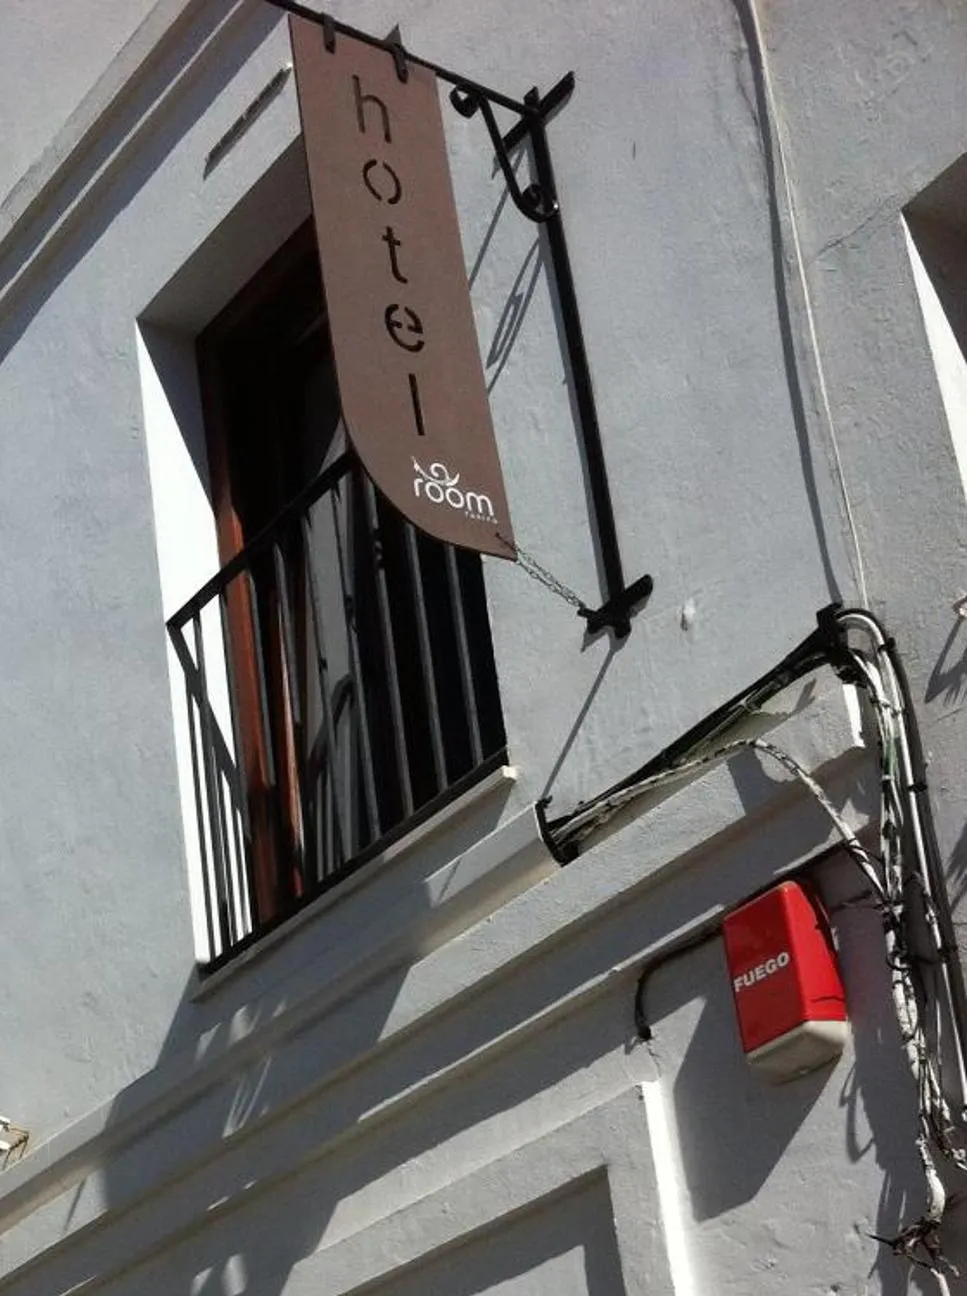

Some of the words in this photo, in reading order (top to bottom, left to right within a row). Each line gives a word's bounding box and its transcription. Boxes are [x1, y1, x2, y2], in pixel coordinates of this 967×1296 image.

[352, 74, 425, 436] hotel
[413, 478, 495, 517] room
[733, 951, 791, 993] FUEGO
